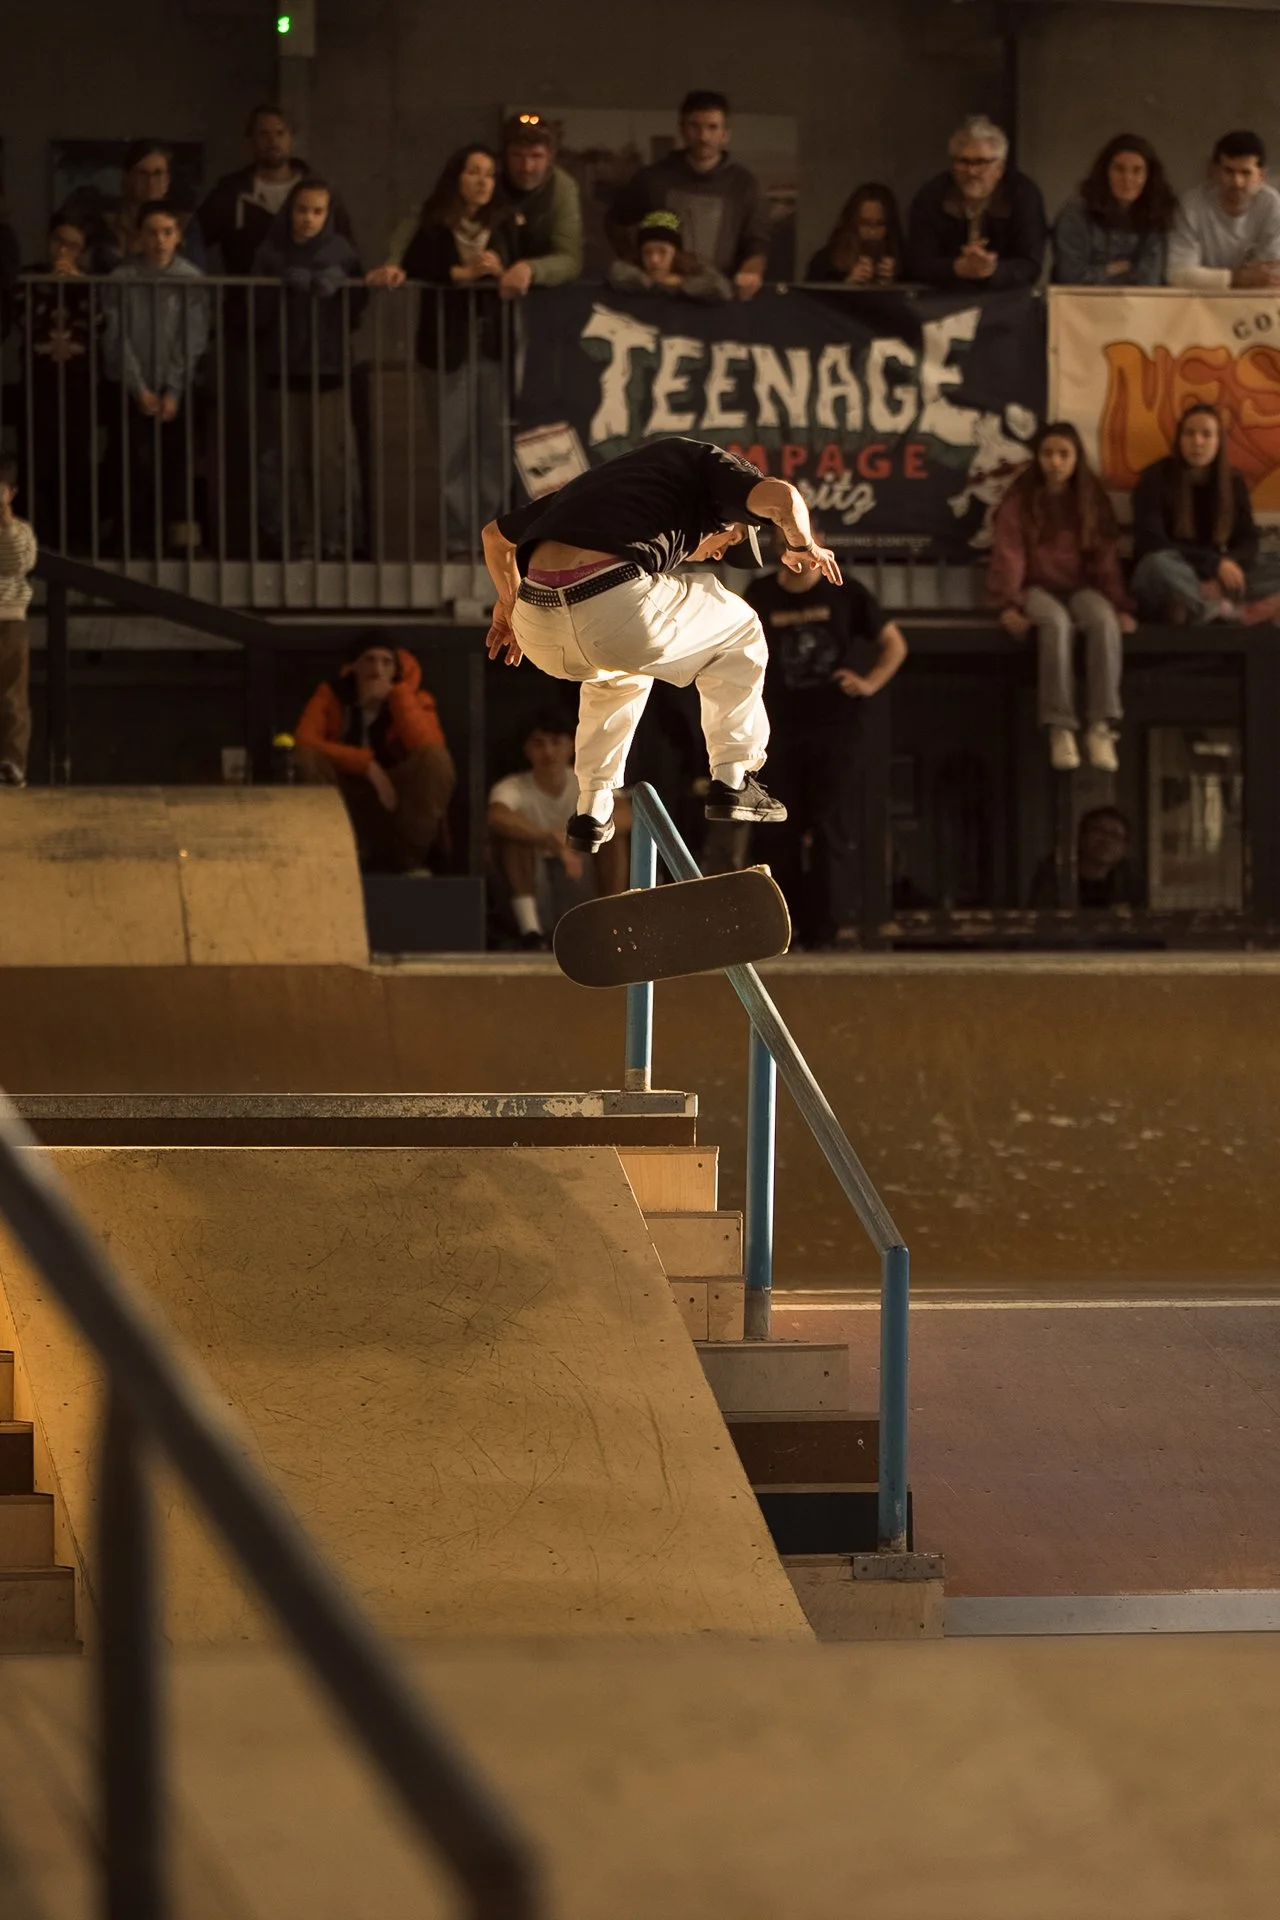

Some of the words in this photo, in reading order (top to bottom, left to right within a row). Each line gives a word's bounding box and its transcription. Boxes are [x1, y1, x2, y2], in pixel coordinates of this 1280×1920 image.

[1231, 308, 1280, 341] CO
[581, 303, 982, 447] TEENAGE
[727, 443, 928, 479] MPAGE
[797, 468, 877, 525] ritz
